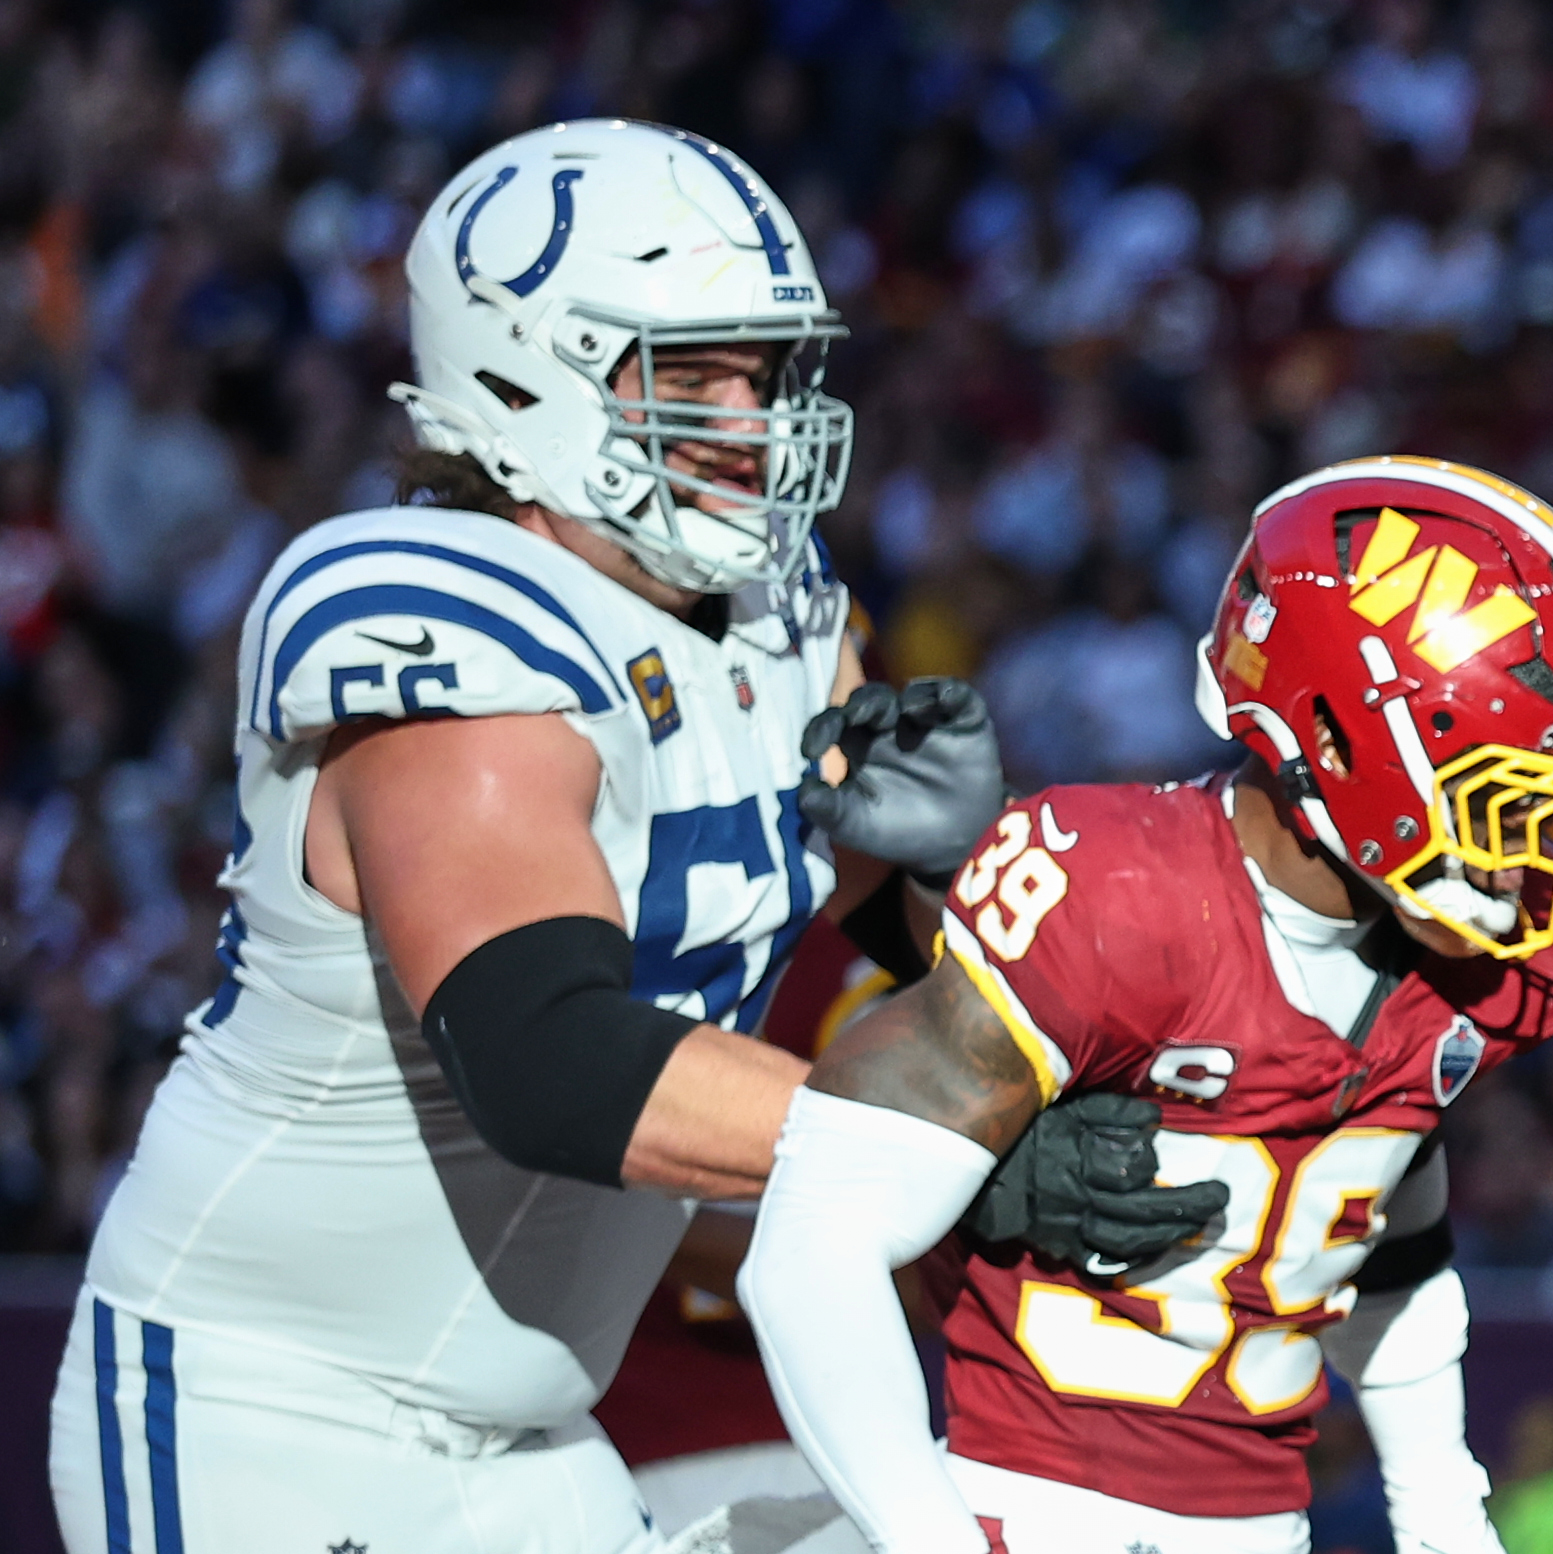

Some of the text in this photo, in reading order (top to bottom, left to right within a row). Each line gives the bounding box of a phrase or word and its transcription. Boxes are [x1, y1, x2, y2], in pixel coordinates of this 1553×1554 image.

[955, 810, 1069, 963] 39
[1149, 1046, 1236, 1099] C
[1015, 1125, 1424, 1416] 39
